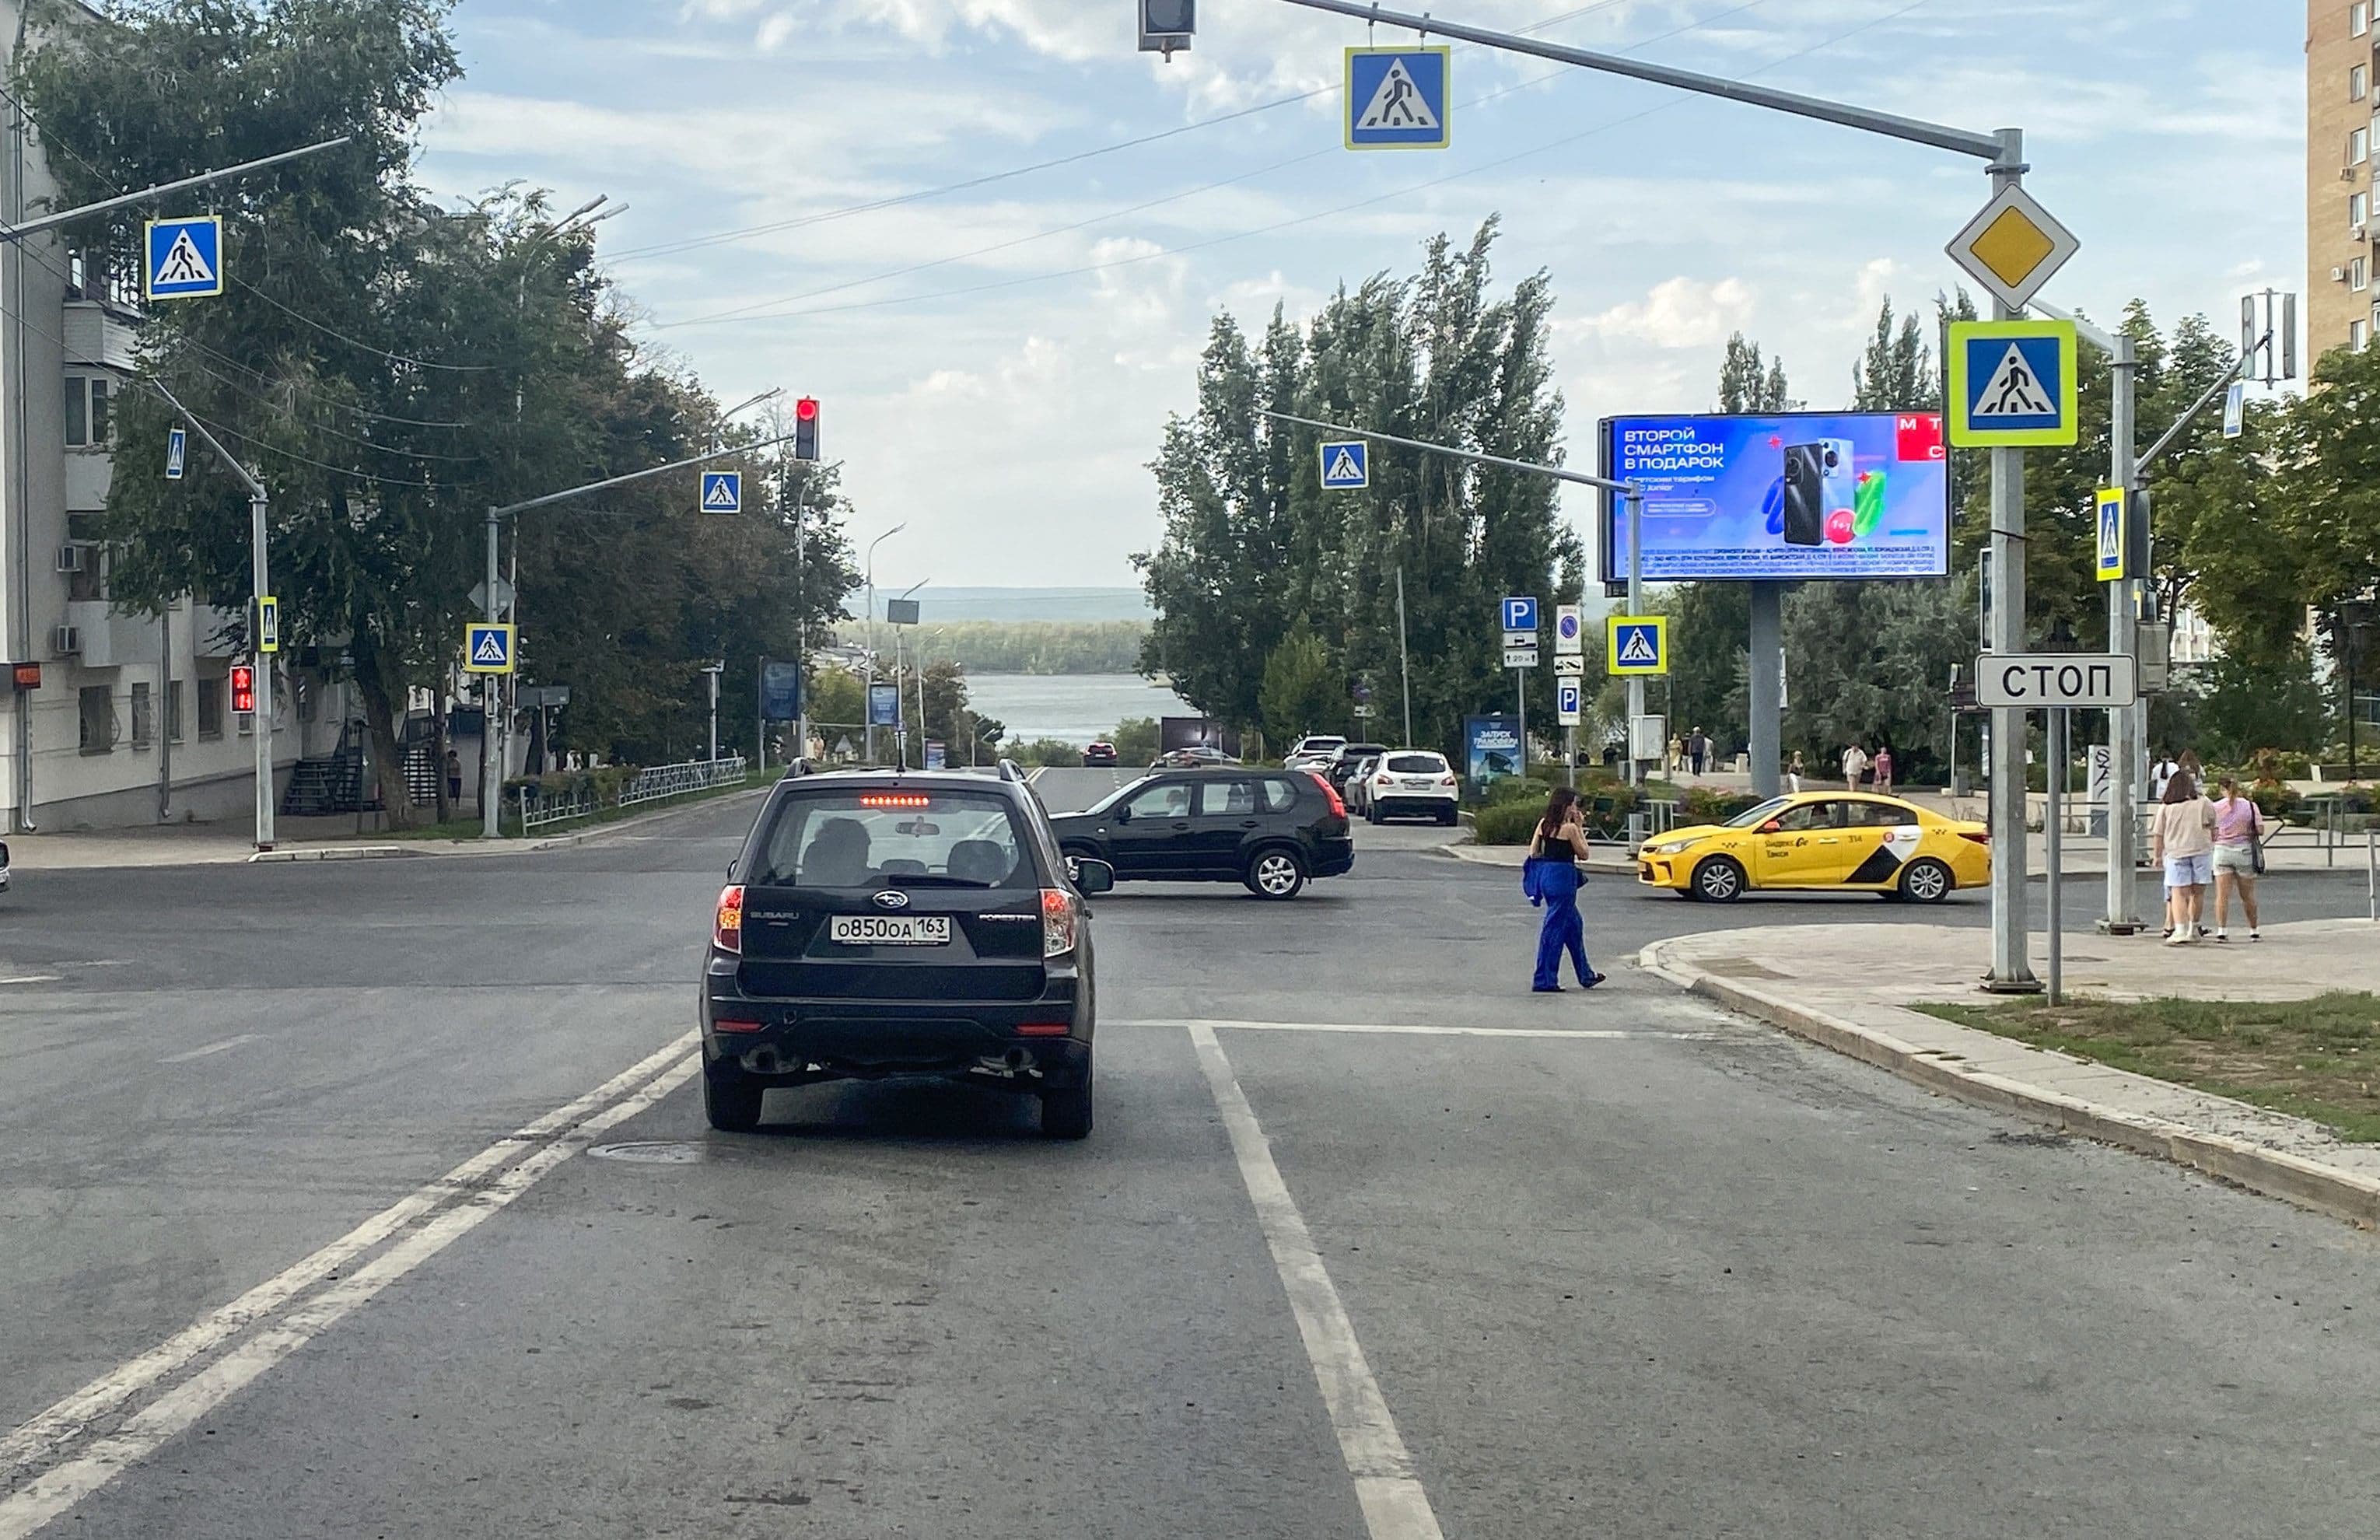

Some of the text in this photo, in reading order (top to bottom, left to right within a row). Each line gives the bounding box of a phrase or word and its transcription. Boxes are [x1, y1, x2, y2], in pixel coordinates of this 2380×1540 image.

[1624, 426, 1696, 443] ВТОРОЙ
[1624, 443, 1724, 456] СМАРТФОН
[1624, 457, 1724, 471] В ПОДАРОК
[1510, 601, 1529, 627] P
[2002, 665, 2111, 698] СТОП
[1564, 689, 1575, 710] P
[838, 918, 945, 938] О850ОА 163
